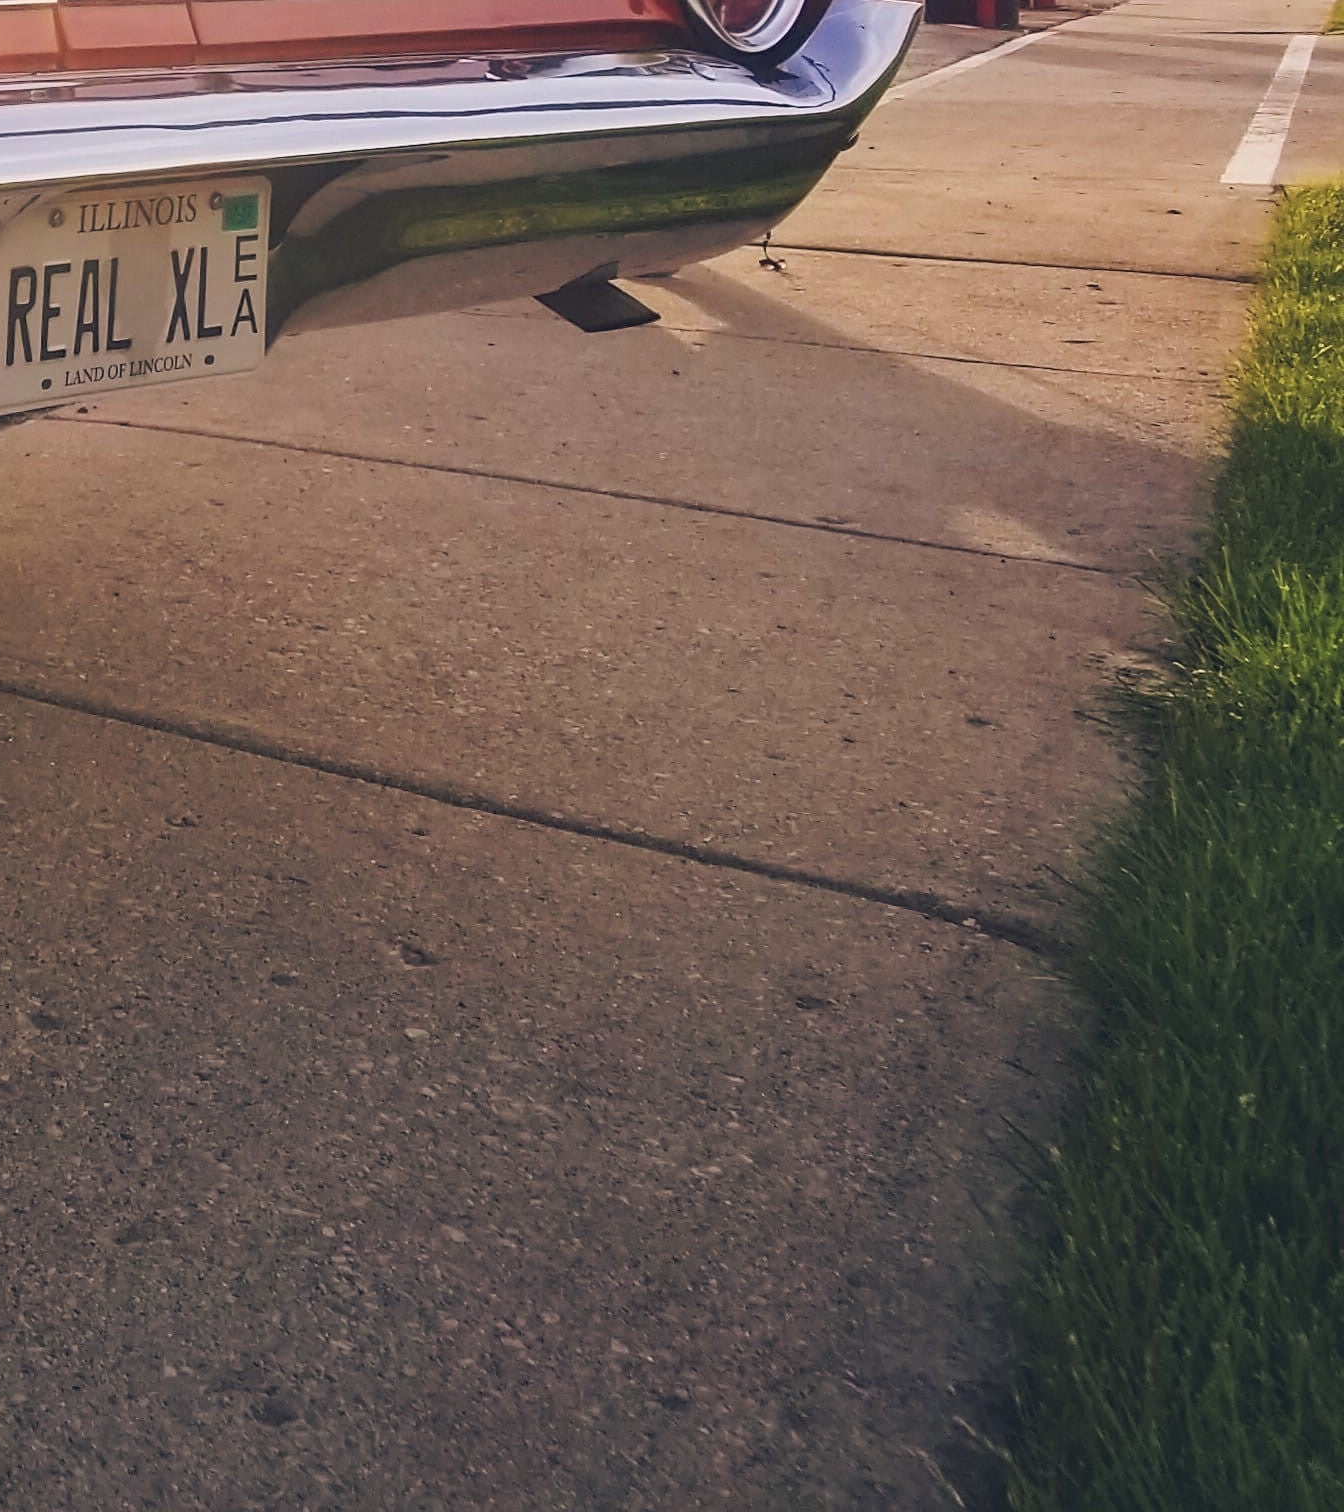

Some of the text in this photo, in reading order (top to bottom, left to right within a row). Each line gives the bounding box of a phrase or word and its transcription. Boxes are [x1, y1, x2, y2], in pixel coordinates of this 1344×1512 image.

[77, 194, 198, 233] ILLINOIS
[6, 246, 223, 366] REAL XL
[64, 353, 193, 386] LAND OF LINCOLN
